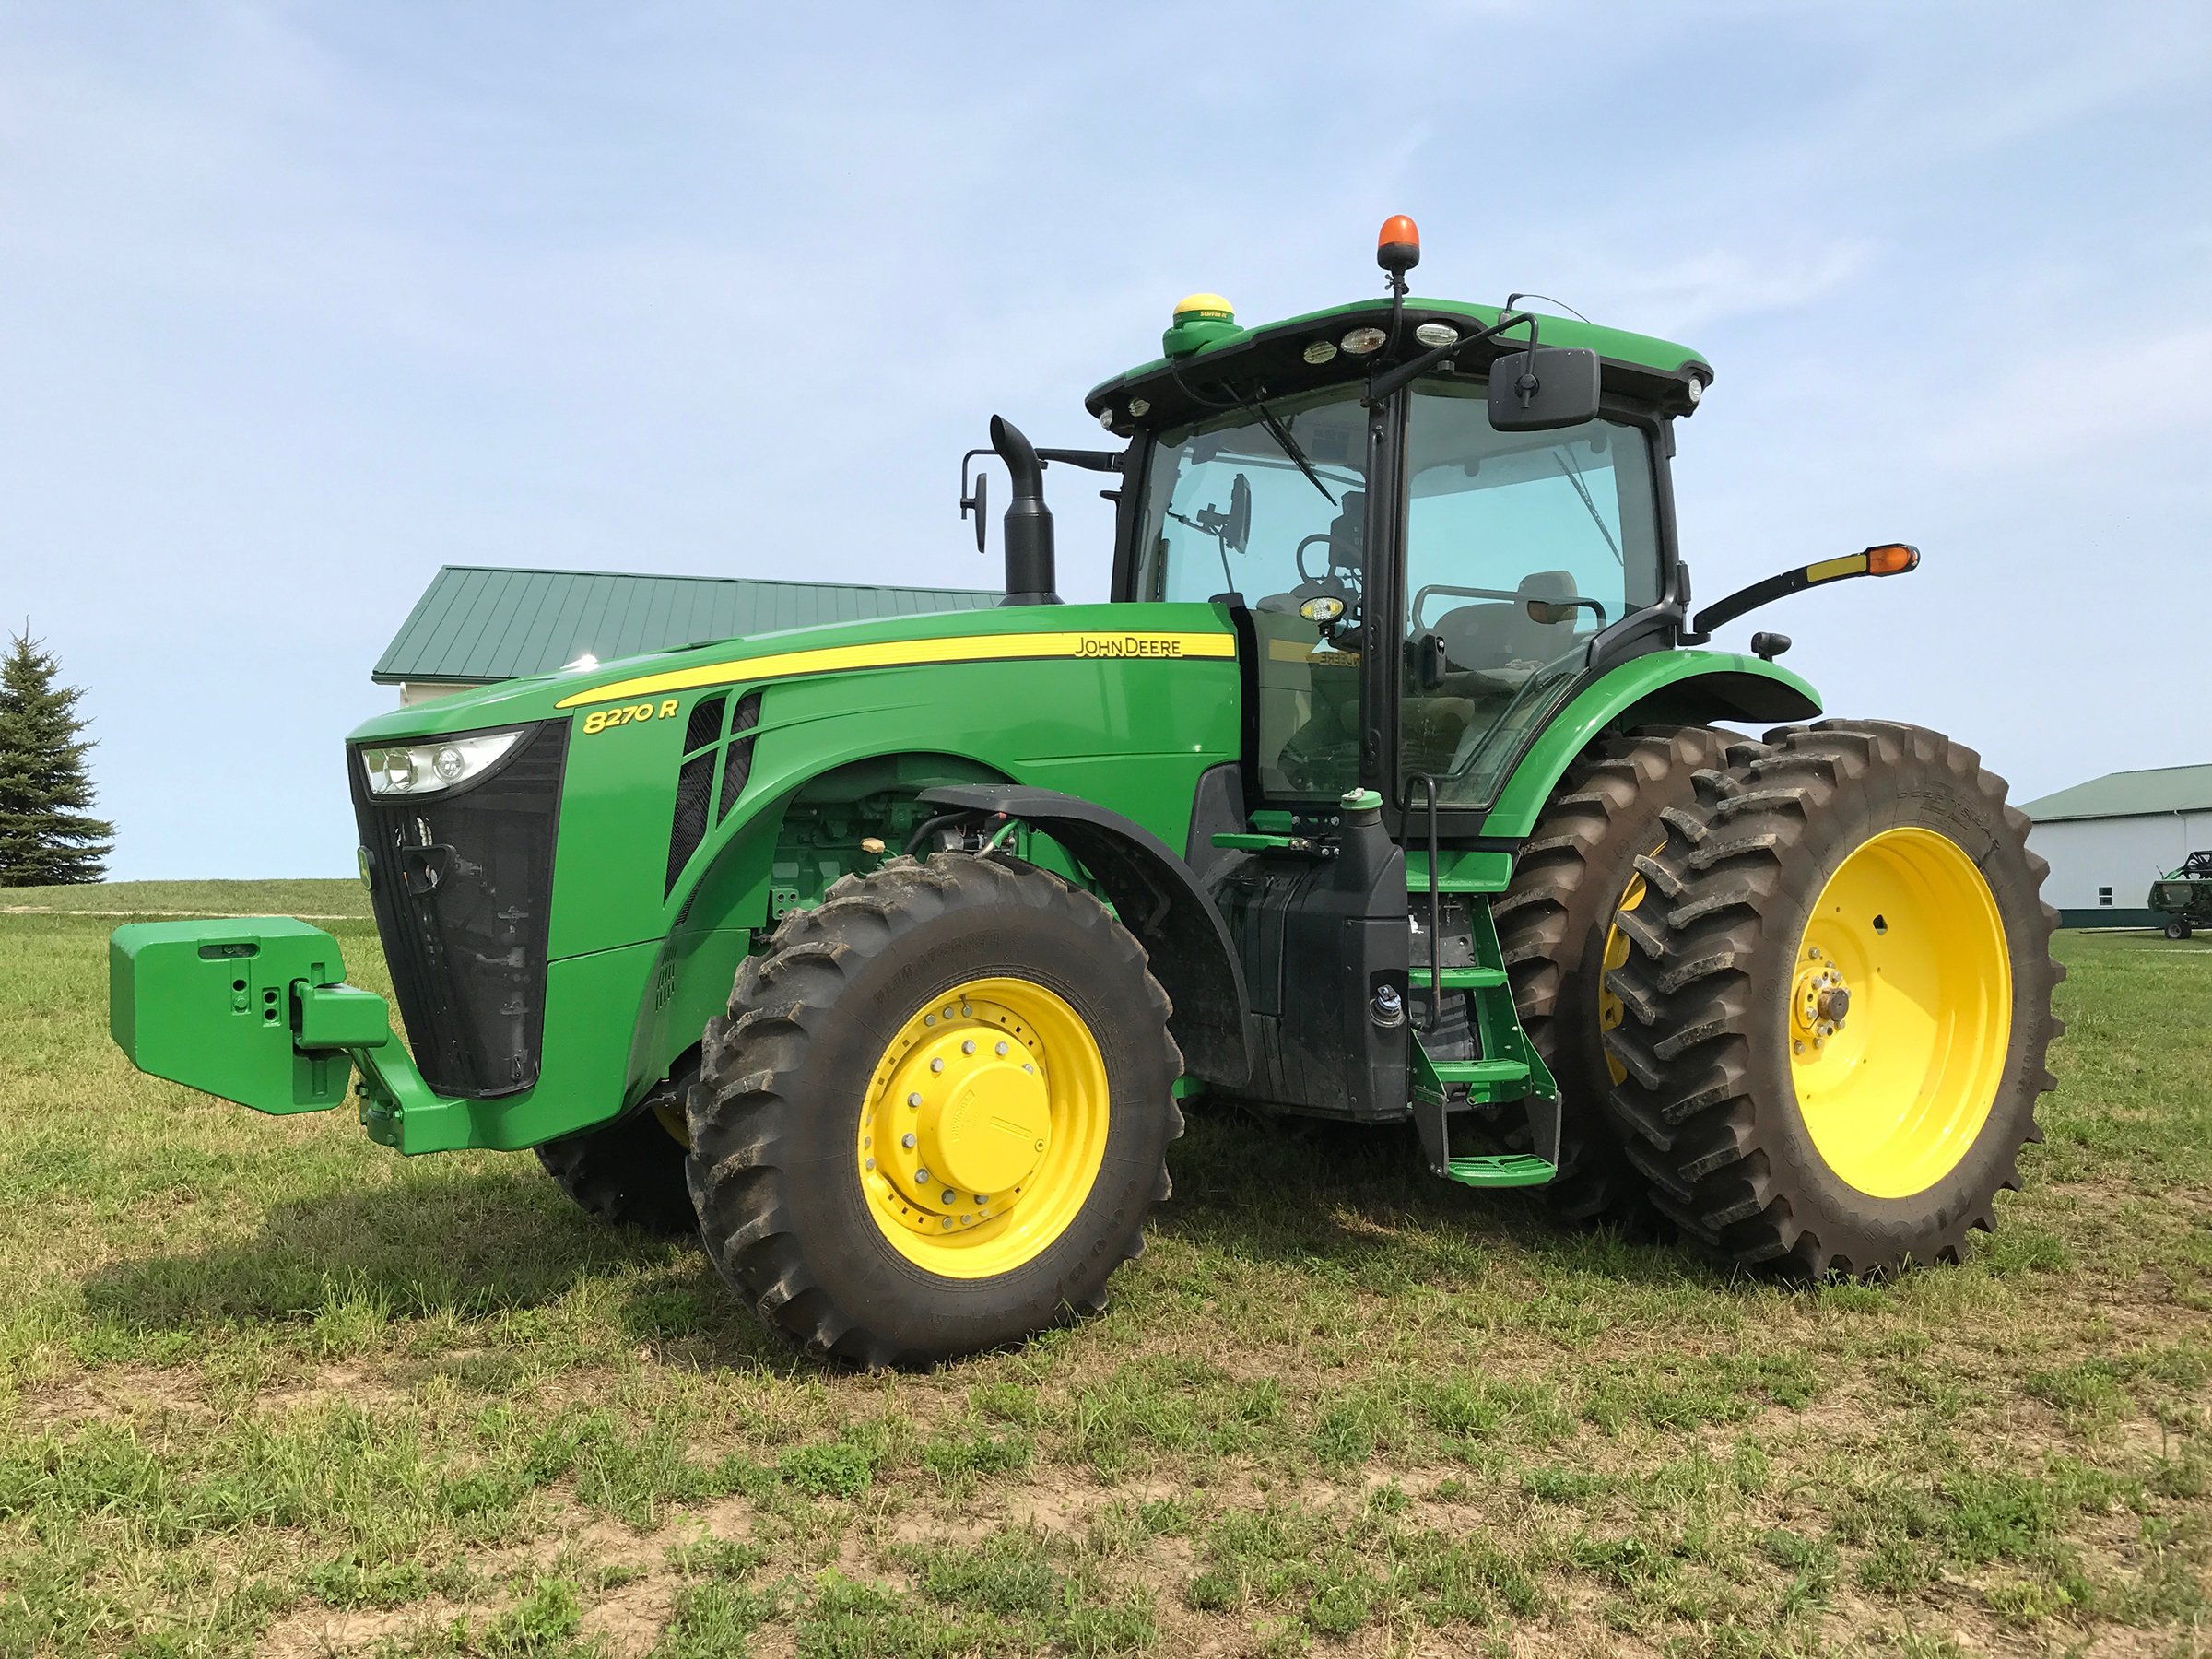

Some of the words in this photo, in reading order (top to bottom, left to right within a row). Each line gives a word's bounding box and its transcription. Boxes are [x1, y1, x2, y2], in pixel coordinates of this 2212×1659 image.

[1075, 637, 1123, 654] JOHN
[1125, 637, 1182, 654] DEERE
[582, 703, 654, 735] 8270
[657, 699, 679, 720] R
